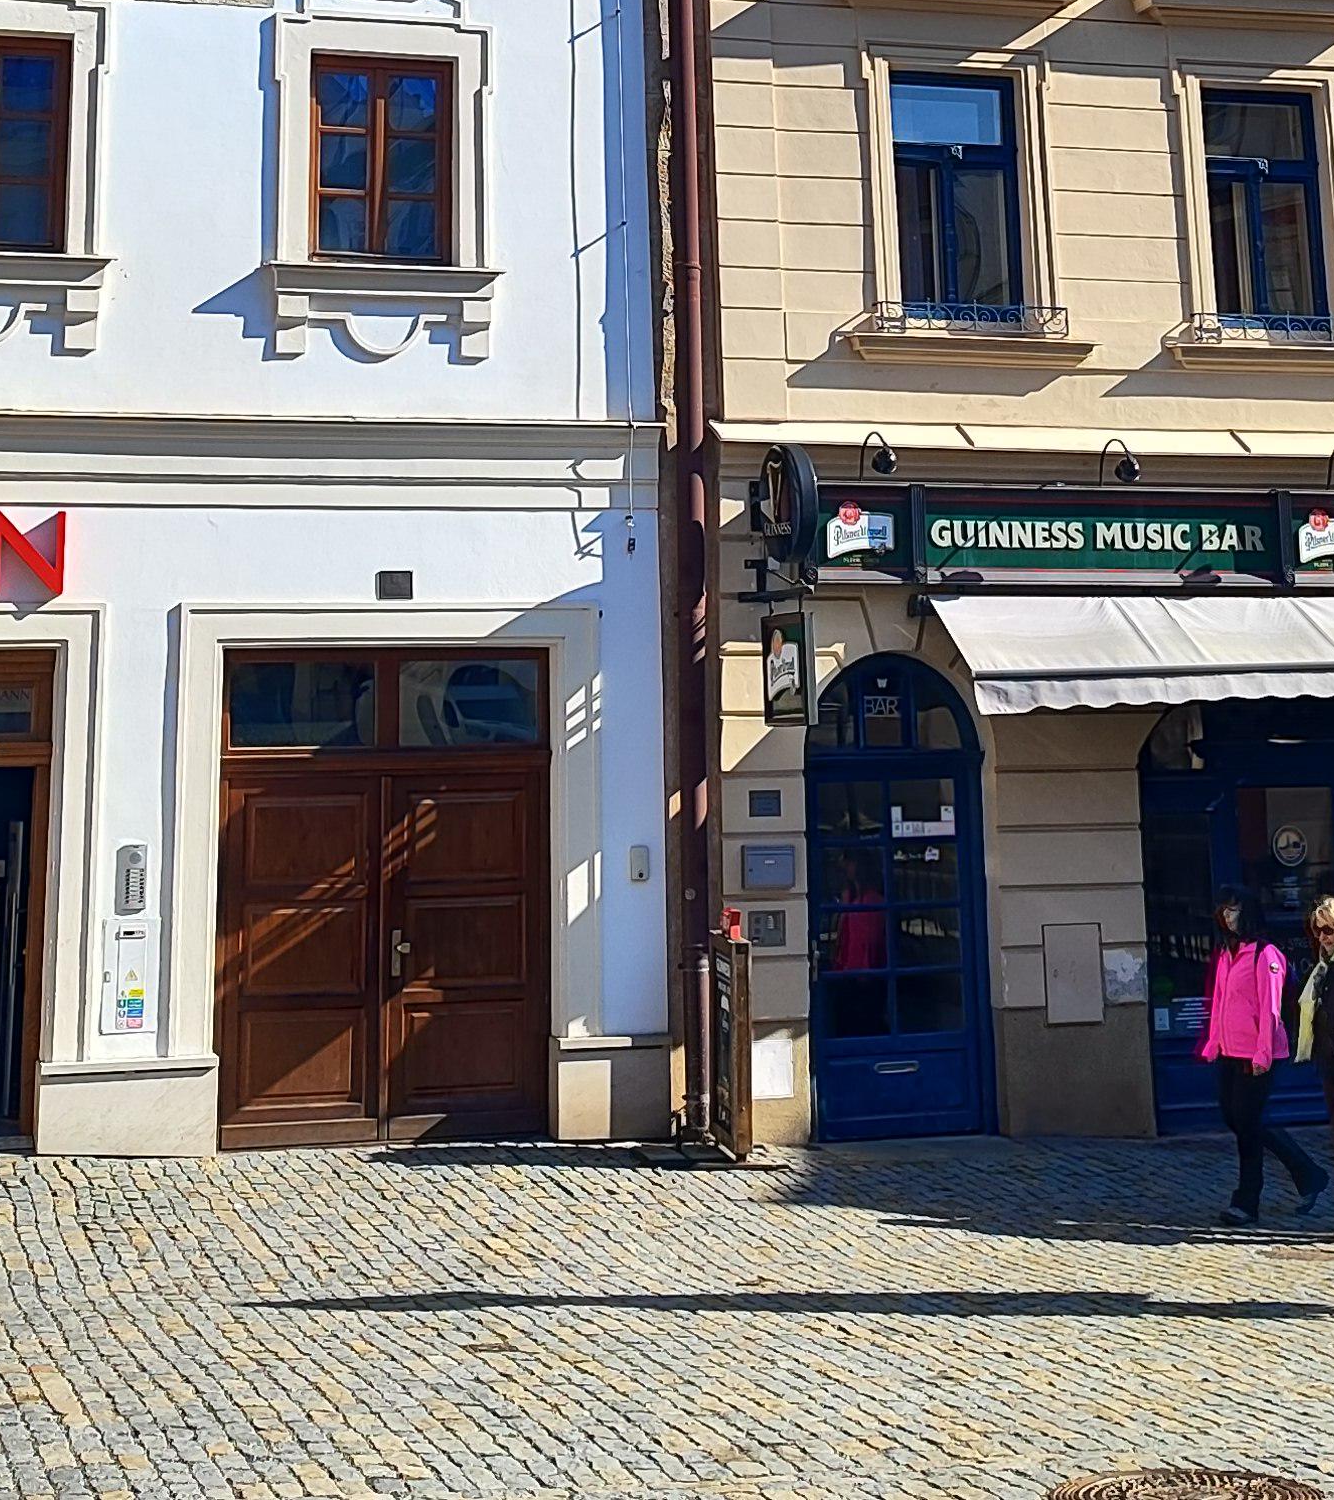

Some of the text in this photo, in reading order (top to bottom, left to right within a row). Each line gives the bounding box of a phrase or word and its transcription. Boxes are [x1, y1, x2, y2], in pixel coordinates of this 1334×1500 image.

[833, 524, 859, 546] Pilsner
[930, 519, 1265, 551] GUINNESS MUSIC BAR
[863, 697, 899, 715] BAR
